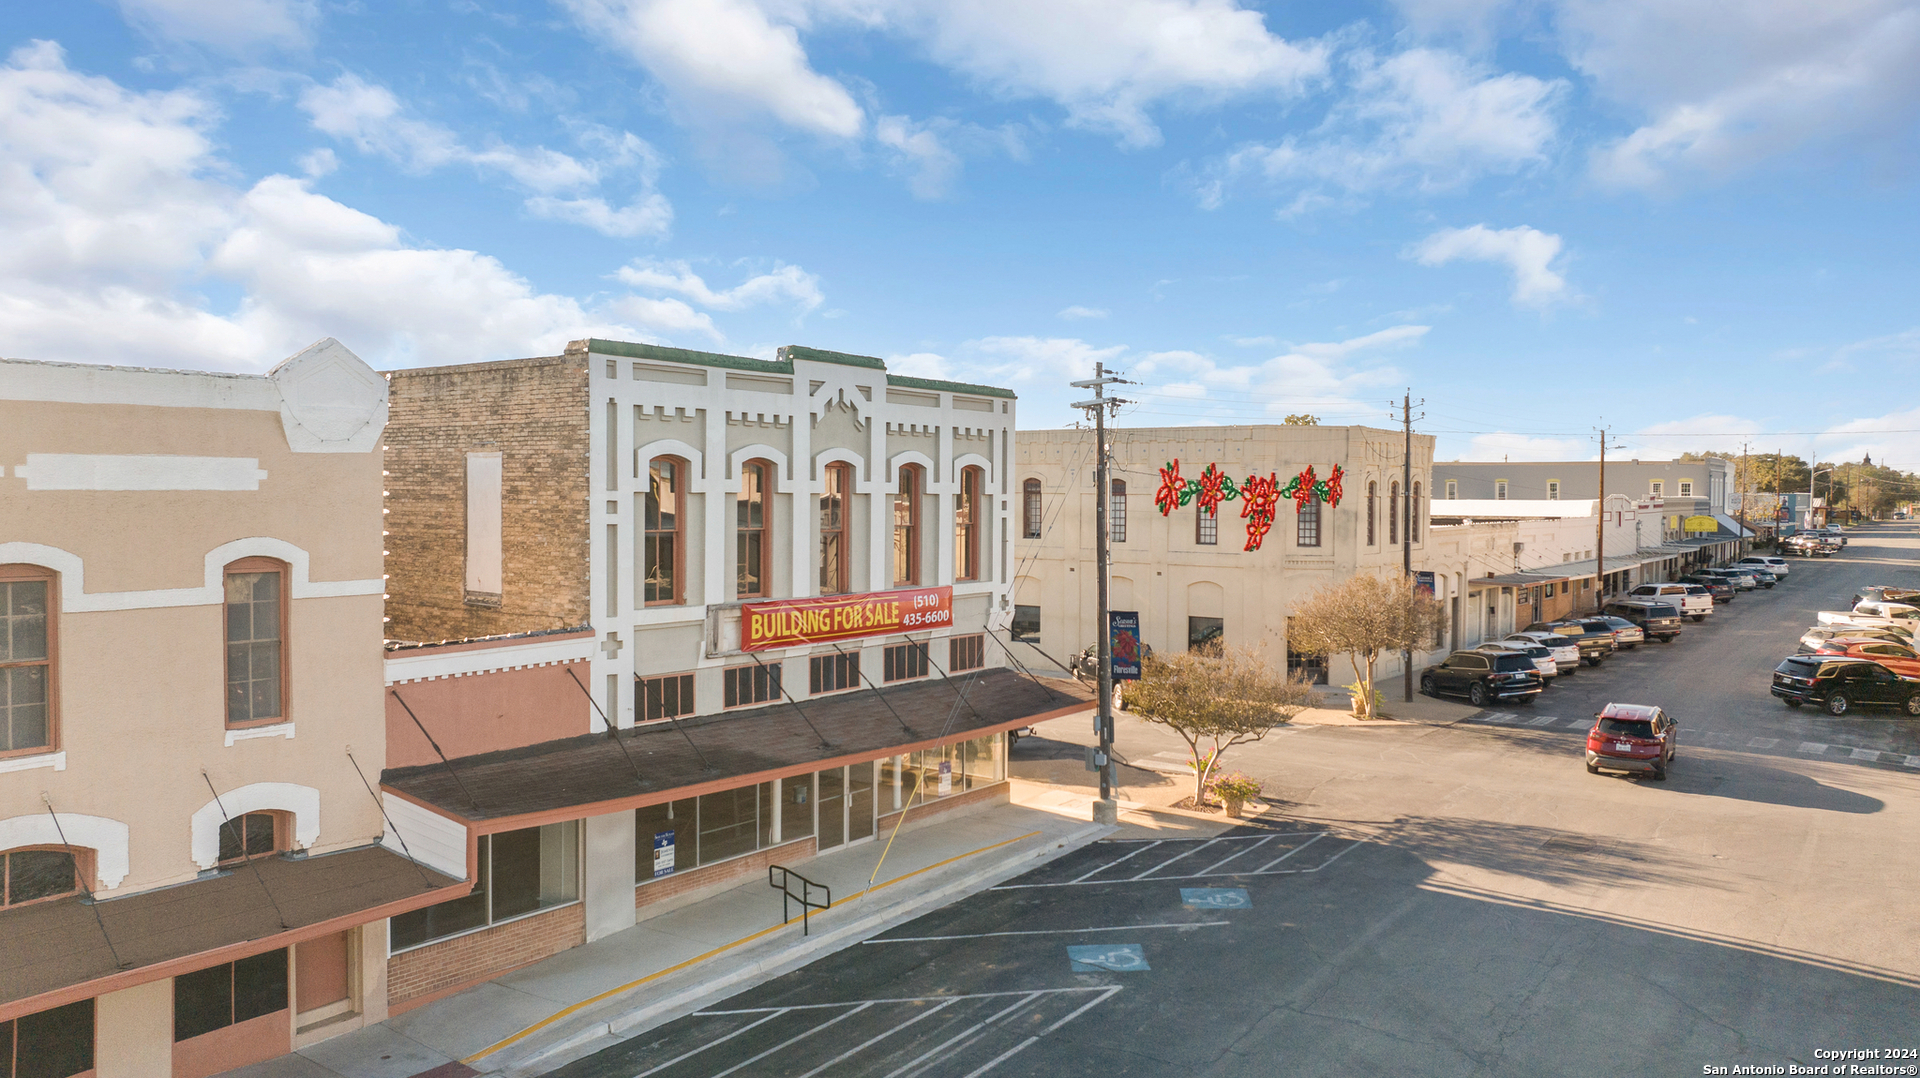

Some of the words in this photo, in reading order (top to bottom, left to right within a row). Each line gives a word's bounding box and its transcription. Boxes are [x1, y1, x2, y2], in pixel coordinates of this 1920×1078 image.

[913, 593, 939, 610] (510)
[751, 608, 831, 640] BUILDING
[834, 605, 863, 630] FOR
[865, 601, 900, 627] SALE
[902, 609, 950, 626] 435-6600
[1113, 665, 1139, 675] Floresville
